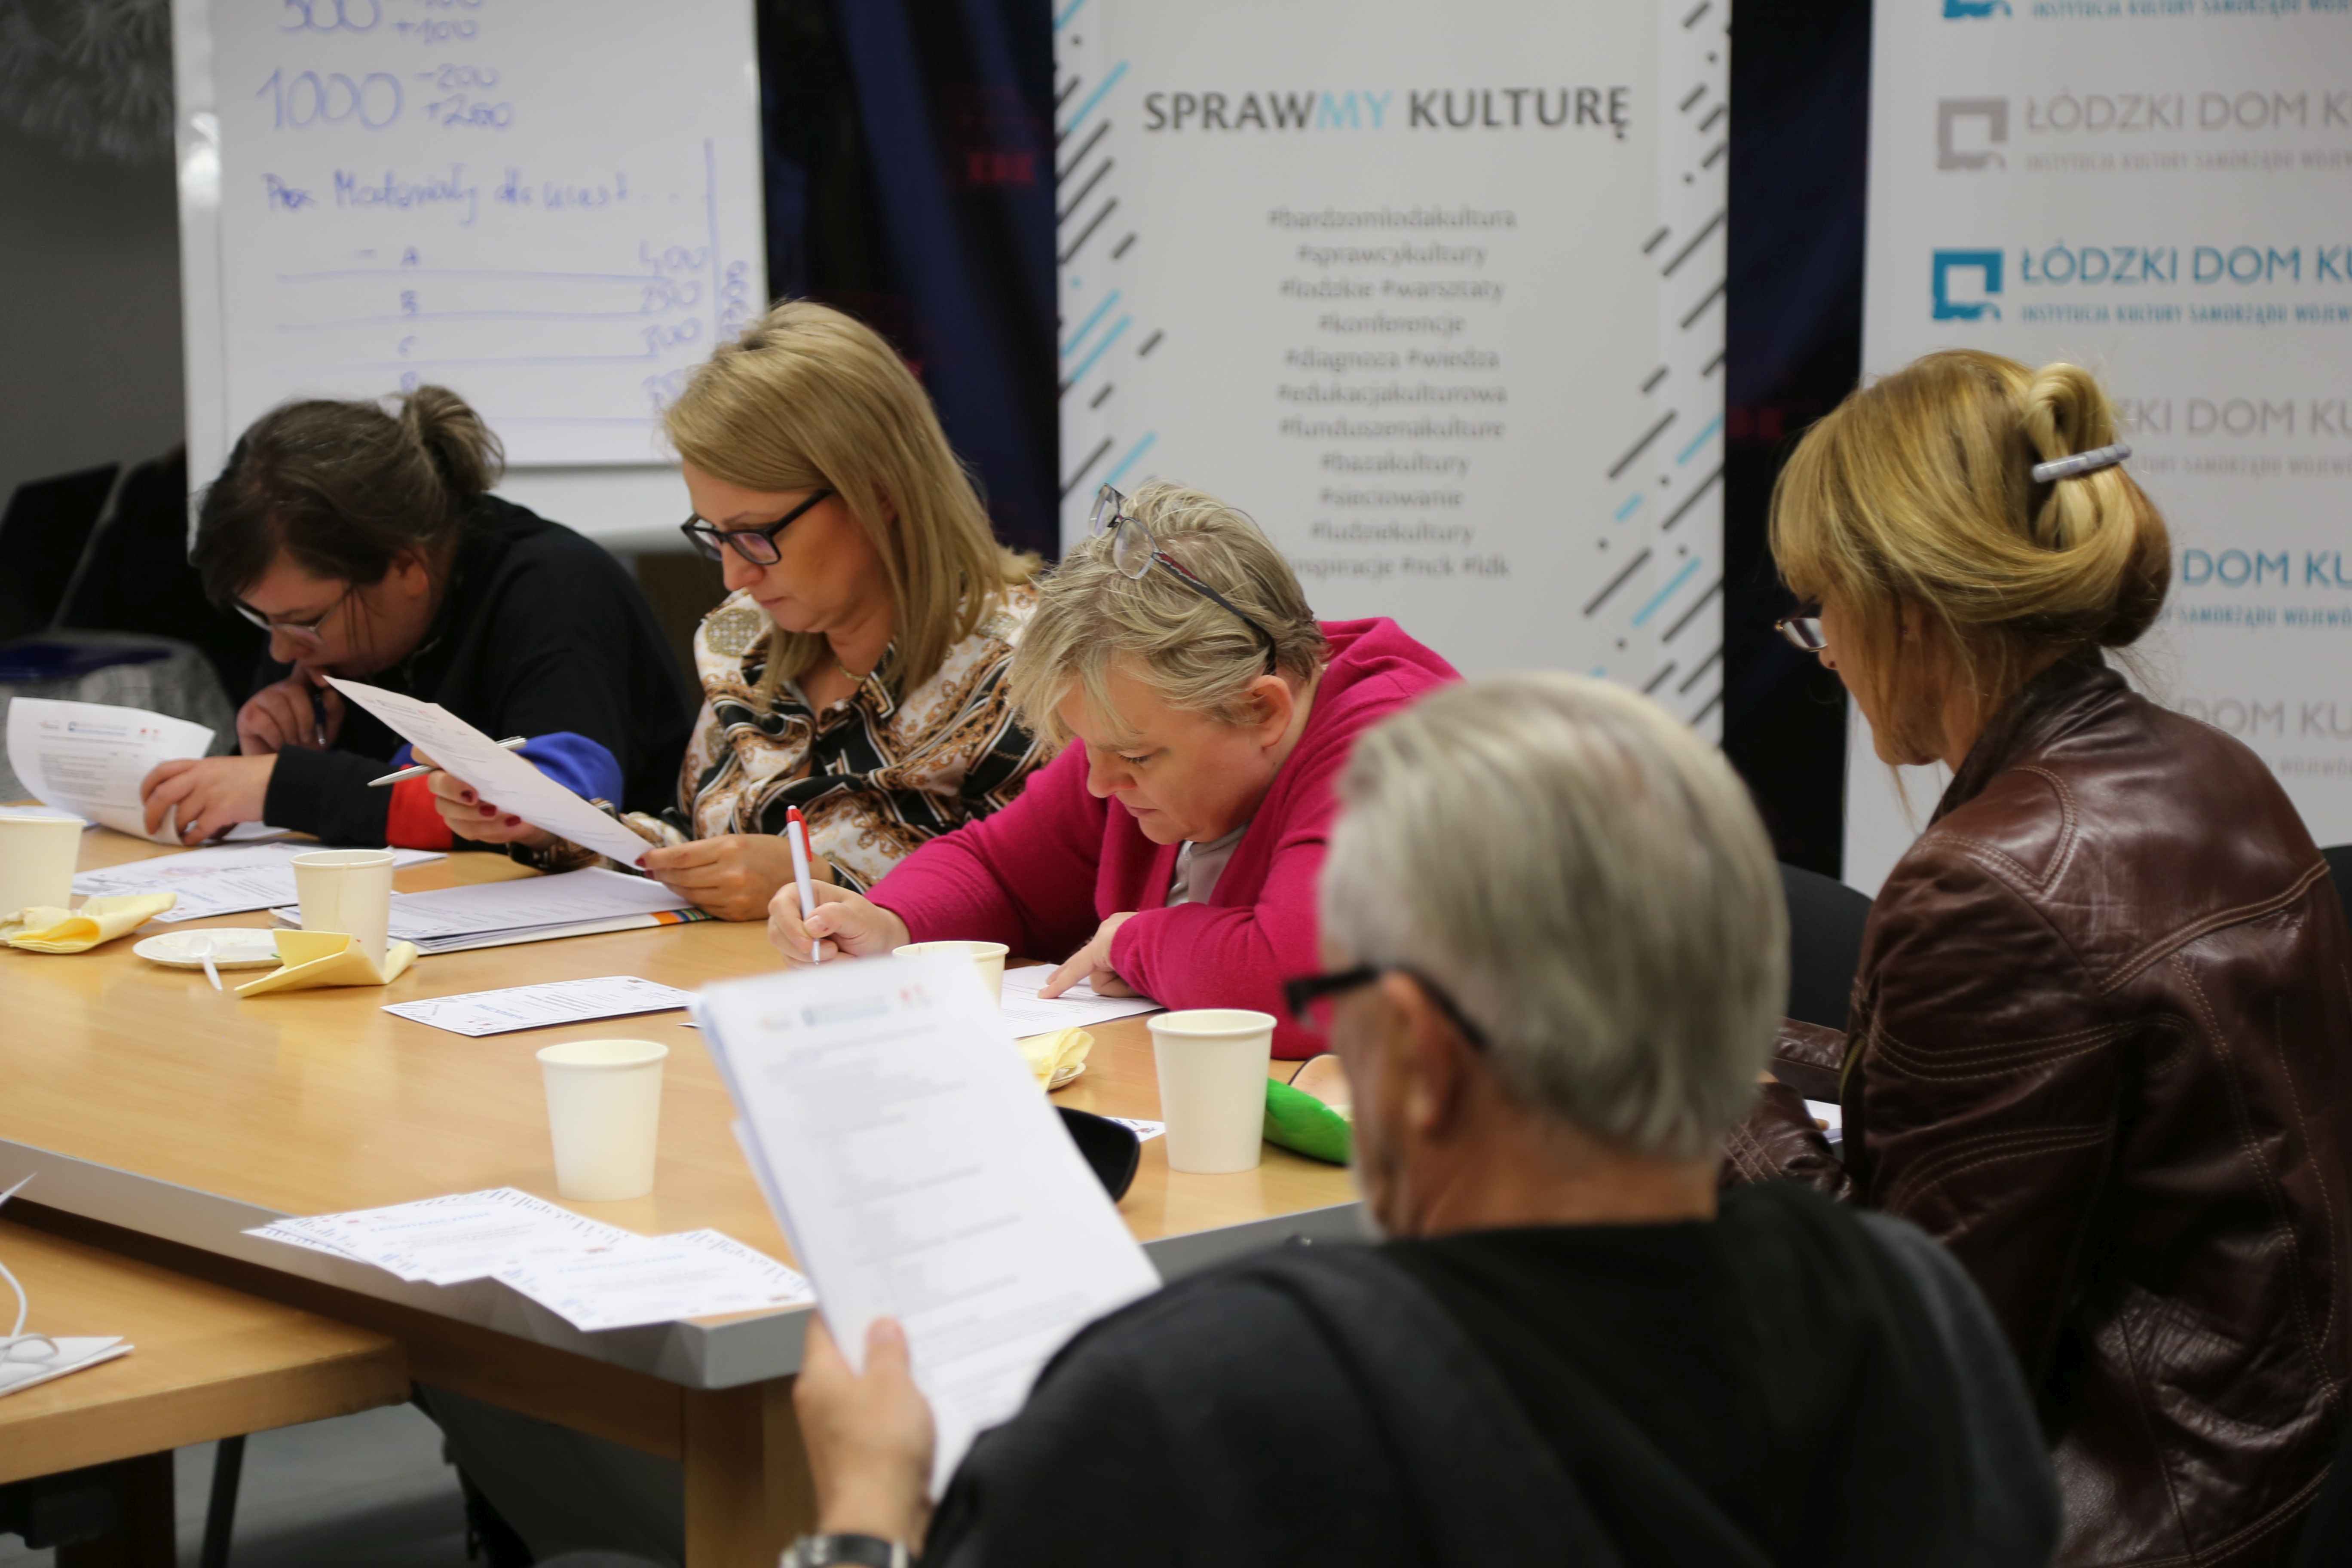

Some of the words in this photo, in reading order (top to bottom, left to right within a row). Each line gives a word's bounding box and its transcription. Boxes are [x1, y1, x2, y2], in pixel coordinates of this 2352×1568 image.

[256, 67, 404, 131] 1000
[1144, 91, 1392, 132] SPRAWMY
[1408, 87, 1632, 141] KULTURĘ
[2025, 85, 2184, 134] ŁÓDZKI
[2198, 89, 2307, 131] DOM
[2322, 90, 2352, 128] K
[2021, 239, 2178, 286] ŁÓDZKI
[2193, 245, 2302, 285] DOM
[2316, 245, 2352, 284] K
[1318, 311, 1466, 341] #konferencje
[2186, 396, 2294, 439] DOM
[2183, 548, 2289, 588] DOM
[2300, 700, 2352, 740] KU
